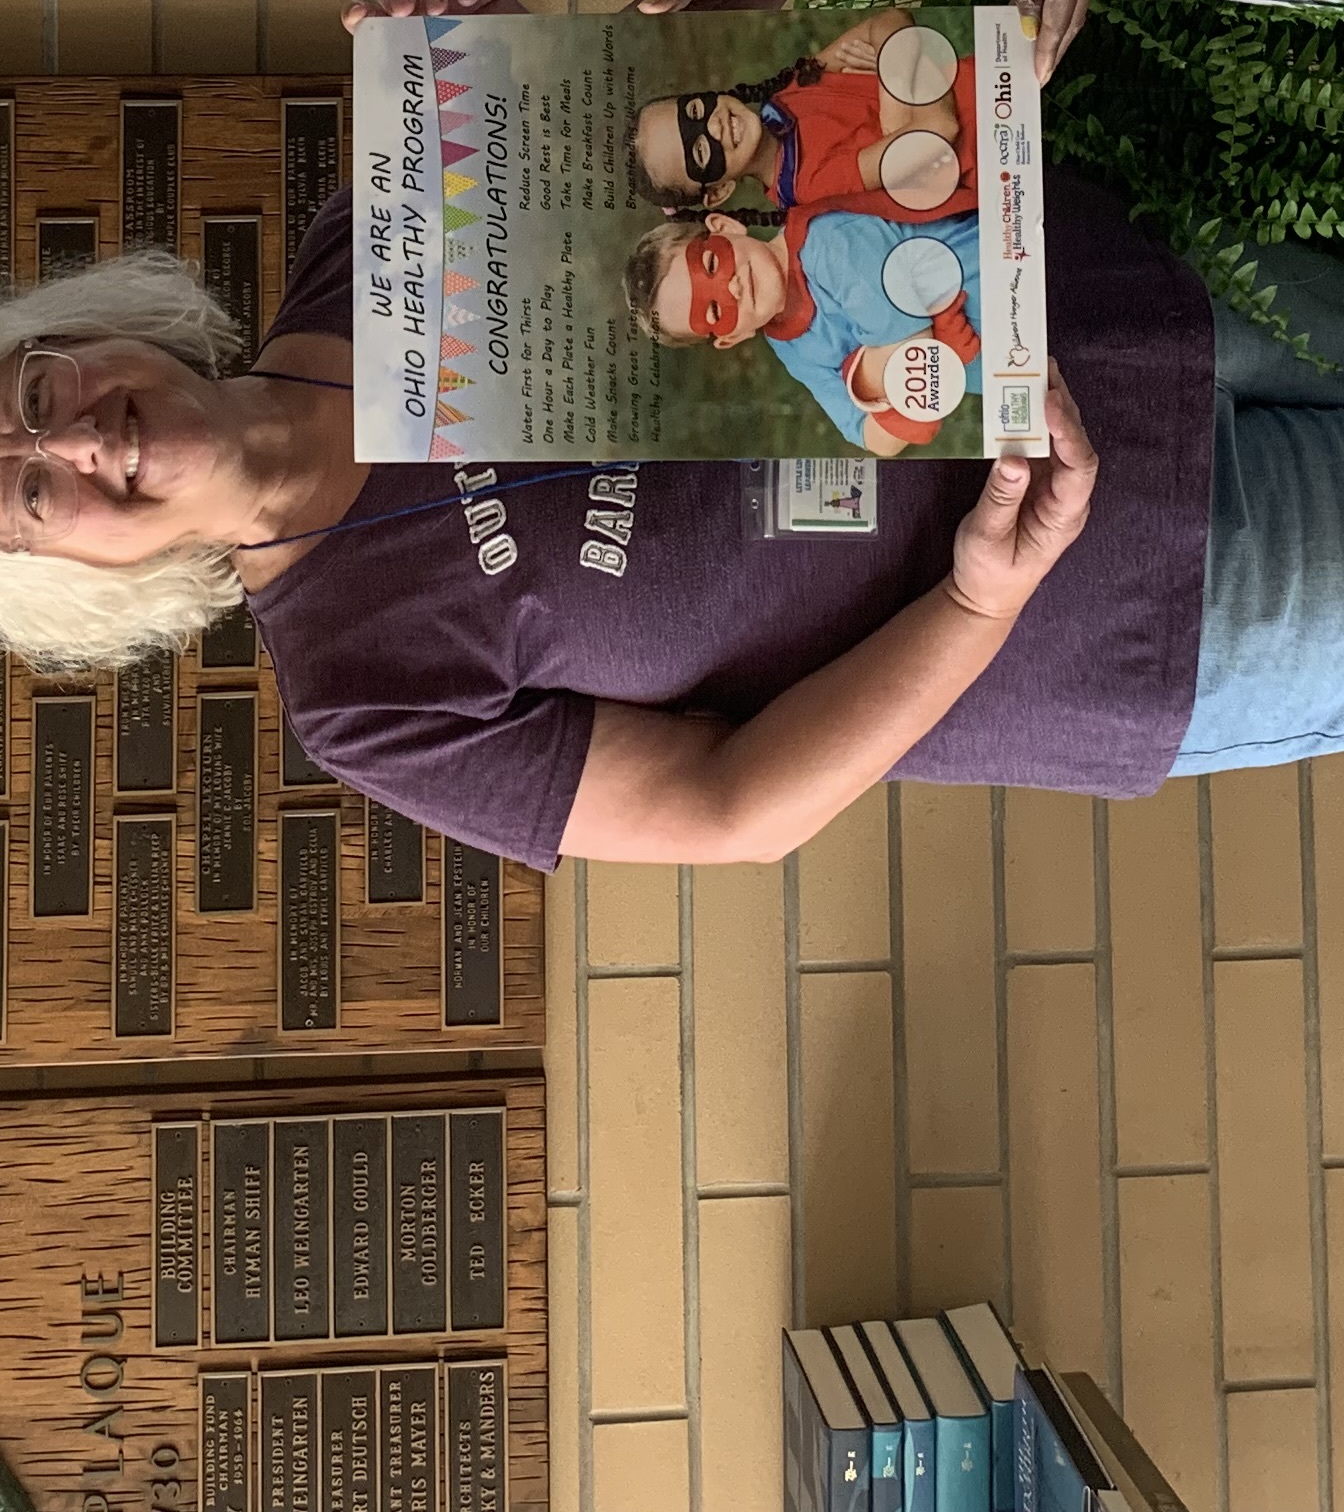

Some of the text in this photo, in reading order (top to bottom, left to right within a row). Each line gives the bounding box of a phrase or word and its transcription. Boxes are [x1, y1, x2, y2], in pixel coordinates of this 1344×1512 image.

[603, 25, 616, 210] Build Children Up with Words
[625, 66, 636, 121] Welcome
[994, 71, 1012, 120] Ohio
[519, 83, 530, 210] Reduce Screen Time
[540, 94, 551, 210] Good Rest is Best
[560, 79, 572, 210] Take Time for Meals
[582, 69, 593, 210] Make Breakfast Count
[368, 151, 393, 317] WE ARE AN
[400, 53, 427, 418] OHIO HEALTHY PROGRAM
[484, 92, 509, 376] CONGRATULATIONS!
[1000, 184, 1013, 260] Healthy Children
[1011, 174, 1025, 213] Weights
[1012, 214, 1023, 250] Healthy
[561, 231, 573, 264] Plate
[541, 284, 554, 310] Play
[543, 317, 552, 331] to
[561, 270, 575, 318] Healthy
[520, 297, 533, 444] Water First for Thirst
[542, 338, 554, 362] Day
[562, 338, 574, 370] Plate
[563, 377, 574, 404] Each
[584, 327, 596, 443] Cold Weather Fun
[606, 318, 618, 443] Make Snacks Count
[628, 351, 639, 385] Great
[650, 310, 663, 442] Healthy Celebrations
[905, 346, 927, 410] 2019
[927, 345, 940, 412] Awarded
[543, 381, 553, 413] Hour
[543, 419, 554, 443] One
[563, 411, 575, 444] Make
[629, 392, 641, 442] Growing
[999, 404, 1010, 424] ohio
[1011, 393, 1019, 424] HEALTHY
[452, 461, 519, 576] OUT
[578, 461, 640, 577] BAR
[201, 733, 213, 875] CHAPEL LECTURN
[453, 846, 463, 989] NORMAN AND JEAN EPSTEIN
[467, 884, 476, 950] IN HONOR OF
[480, 879, 489, 952] OUR CHILDREN
[160, 1191, 176, 1279] BUILDING
[177, 1176, 194, 1293] COMMITTEE
[223, 1188, 237, 1275] CHAIRMAN
[244, 1164, 261, 1299] HYMAN SHIFF
[293, 1145, 310, 1314] LEO WEINGARTEN
[353, 1151, 369, 1300] EDWARD GOULD
[399, 1182, 416, 1262] MORTON
[421, 1160, 438, 1286] GOLDBERGER
[469, 1161, 485, 1281] TED ECKER
[80, 1271, 127, 1512] PLAQUE
[389, 1381, 402, 1477] TREASURER
[411, 1401, 427, 1467] MAYER
[479, 1370, 496, 1460] MANDERS
[150, 1446, 182, 1512] 30
[206, 1394, 216, 1506] BUILDING FUND
[218, 1409, 229, 1491] CHAIRMAN
[271, 1415, 284, 1507] PRESIDENT
[331, 1430, 343, 1512] EASURER
[351, 1396, 368, 1481] DEUTSCH
[481, 1466, 496, 1479] &
